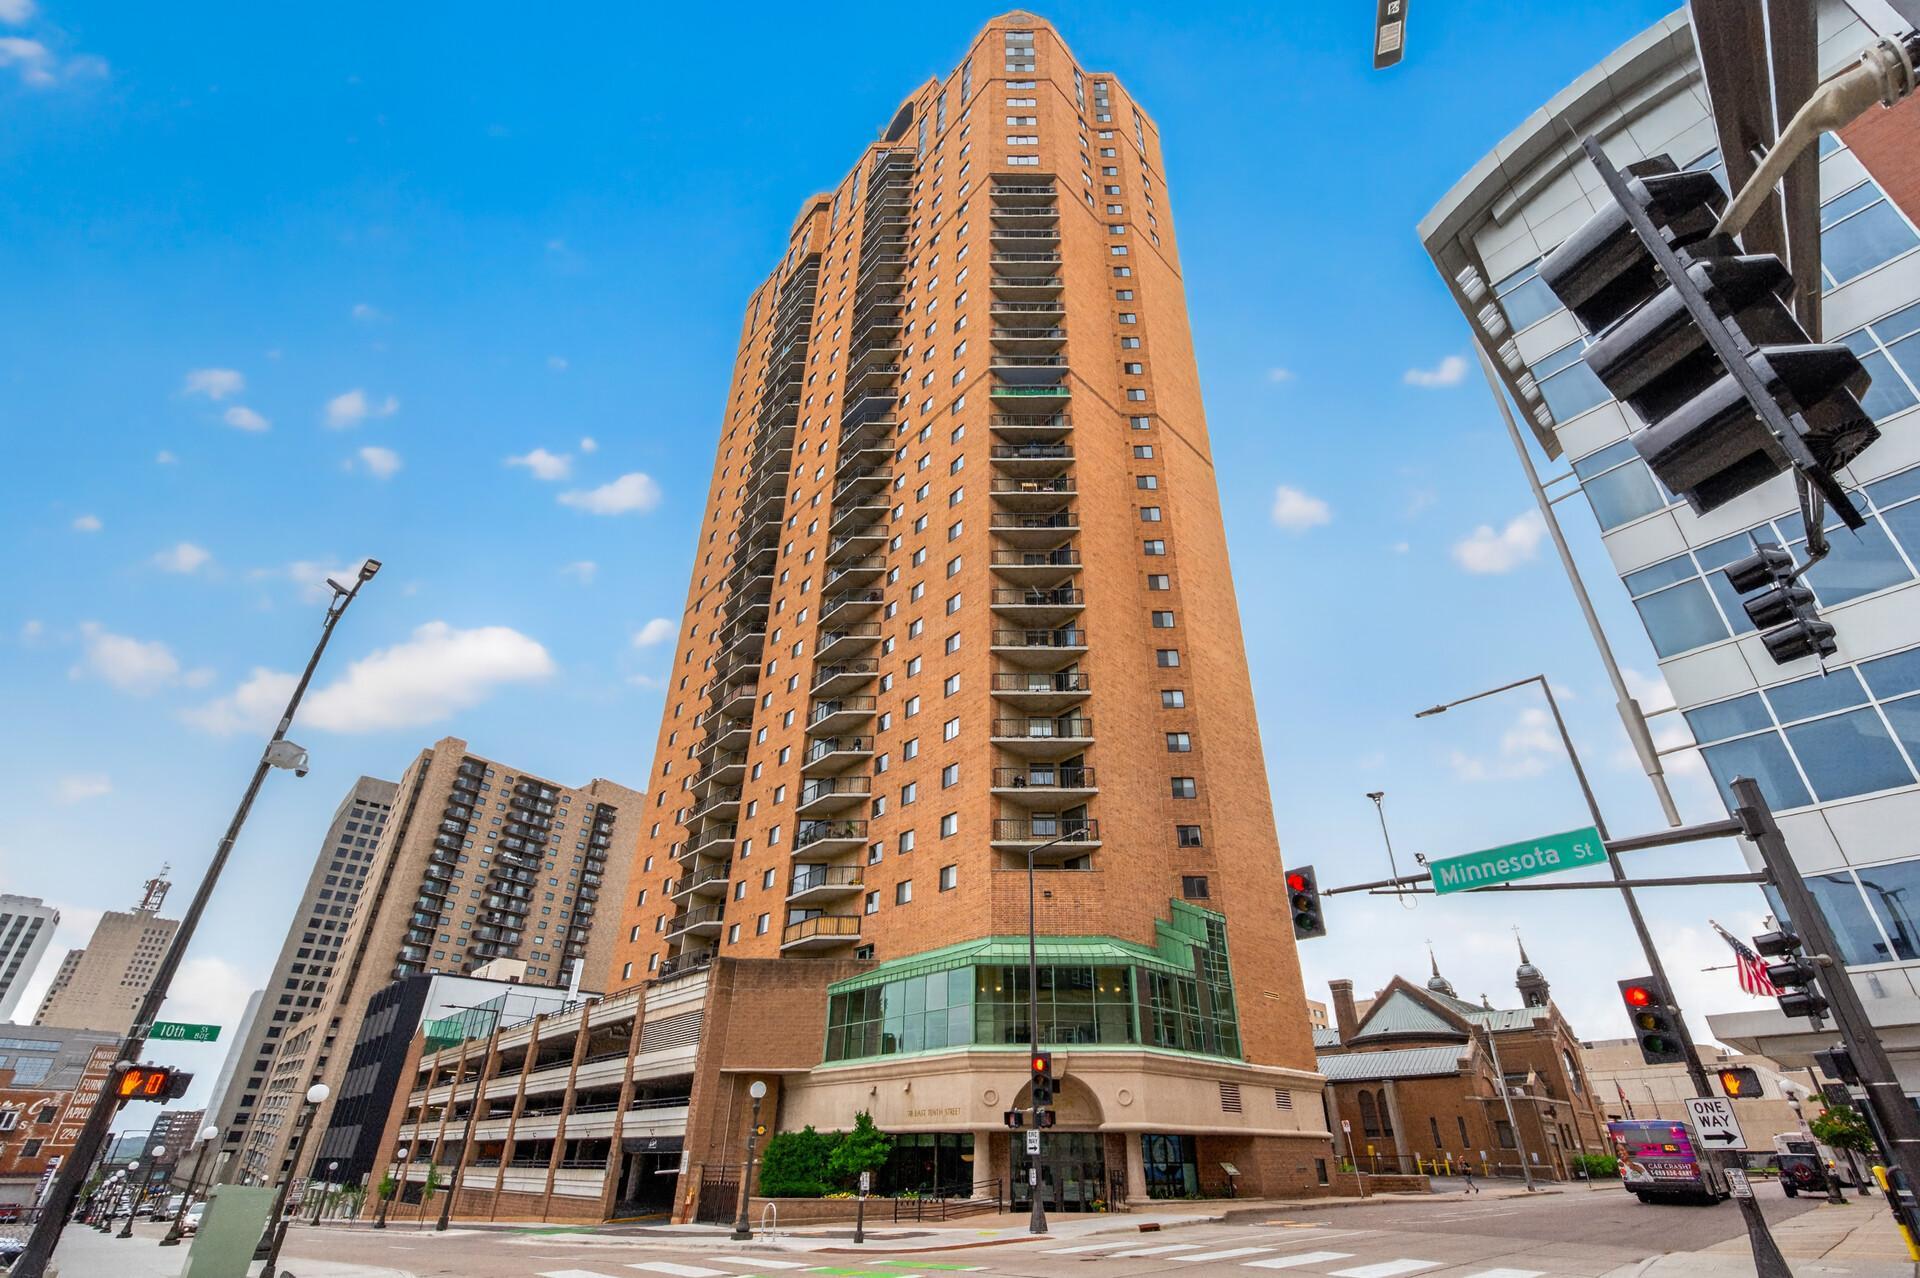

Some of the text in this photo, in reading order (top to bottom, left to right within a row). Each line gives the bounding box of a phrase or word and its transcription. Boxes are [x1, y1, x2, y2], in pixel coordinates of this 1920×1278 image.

[1440, 842, 1594, 886] Minnesota St
[160, 1025, 186, 1038] 10th
[944, 1107, 961, 1116] STREET
[1693, 1101, 1725, 1114] ONE
[1698, 1114, 1729, 1127] WAY
